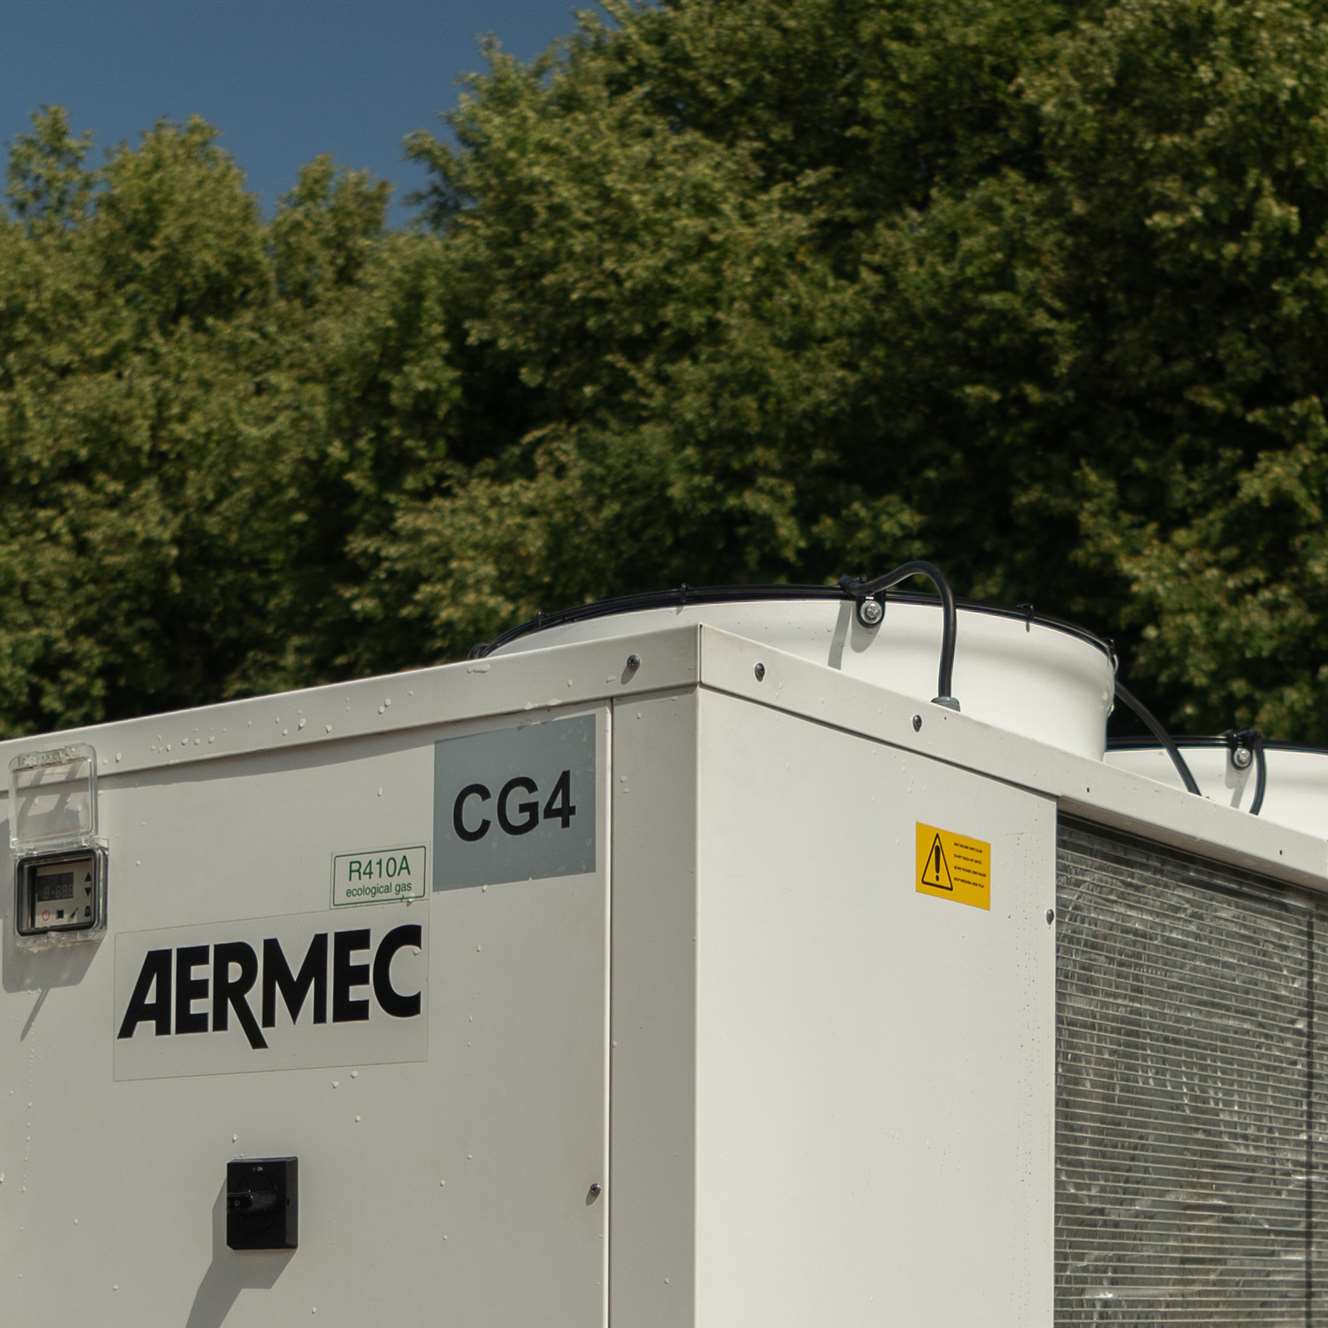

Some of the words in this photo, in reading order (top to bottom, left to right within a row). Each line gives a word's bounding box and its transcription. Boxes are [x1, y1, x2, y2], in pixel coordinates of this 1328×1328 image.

[453, 769, 576, 842] CG4
[346, 882, 393, 898] ecological
[394, 882, 413, 896] gas
[348, 855, 411, 881] R410A
[117, 924, 422, 1050] AERMEC
